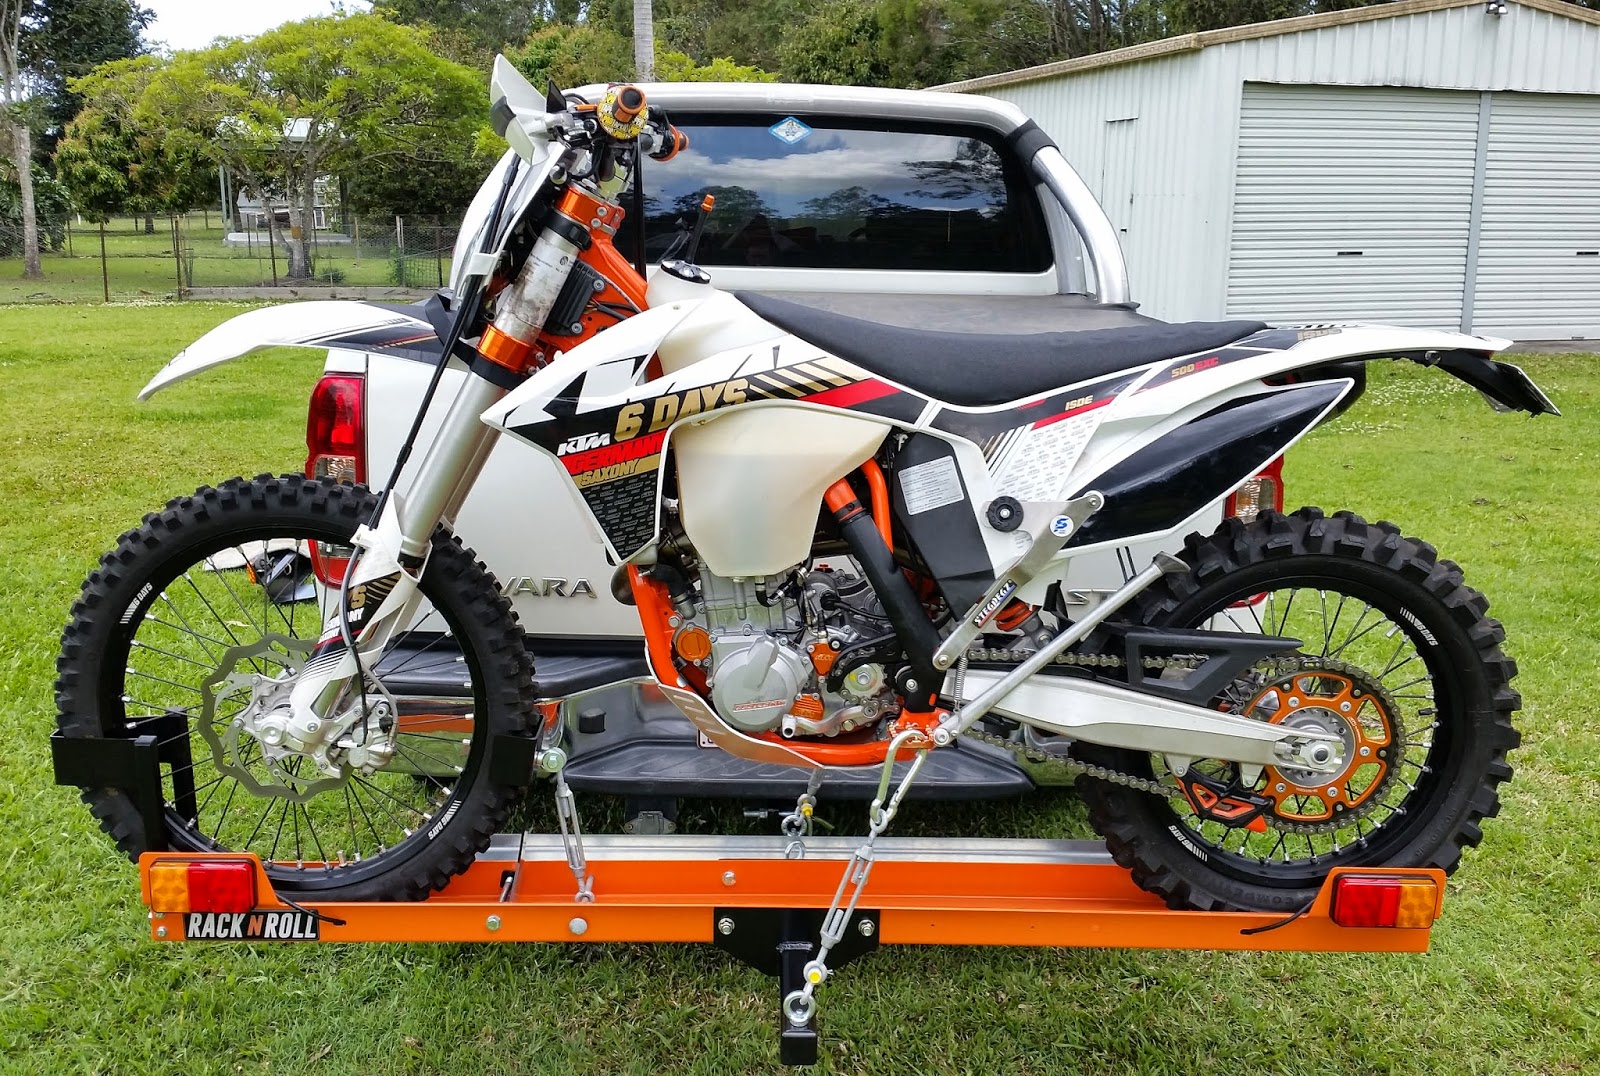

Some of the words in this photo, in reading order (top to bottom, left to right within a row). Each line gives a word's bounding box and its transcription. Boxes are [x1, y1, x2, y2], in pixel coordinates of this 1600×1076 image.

[614, 402, 645, 442] 6
[648, 378, 748, 433] DAYS
[557, 432, 610, 456] KTM
[580, 458, 640, 487] SAXONY
[136, 582, 153, 601] DAYS
[187, 912, 246, 938] RACK
[247, 915, 264, 936] N
[264, 912, 316, 938] ROLL
